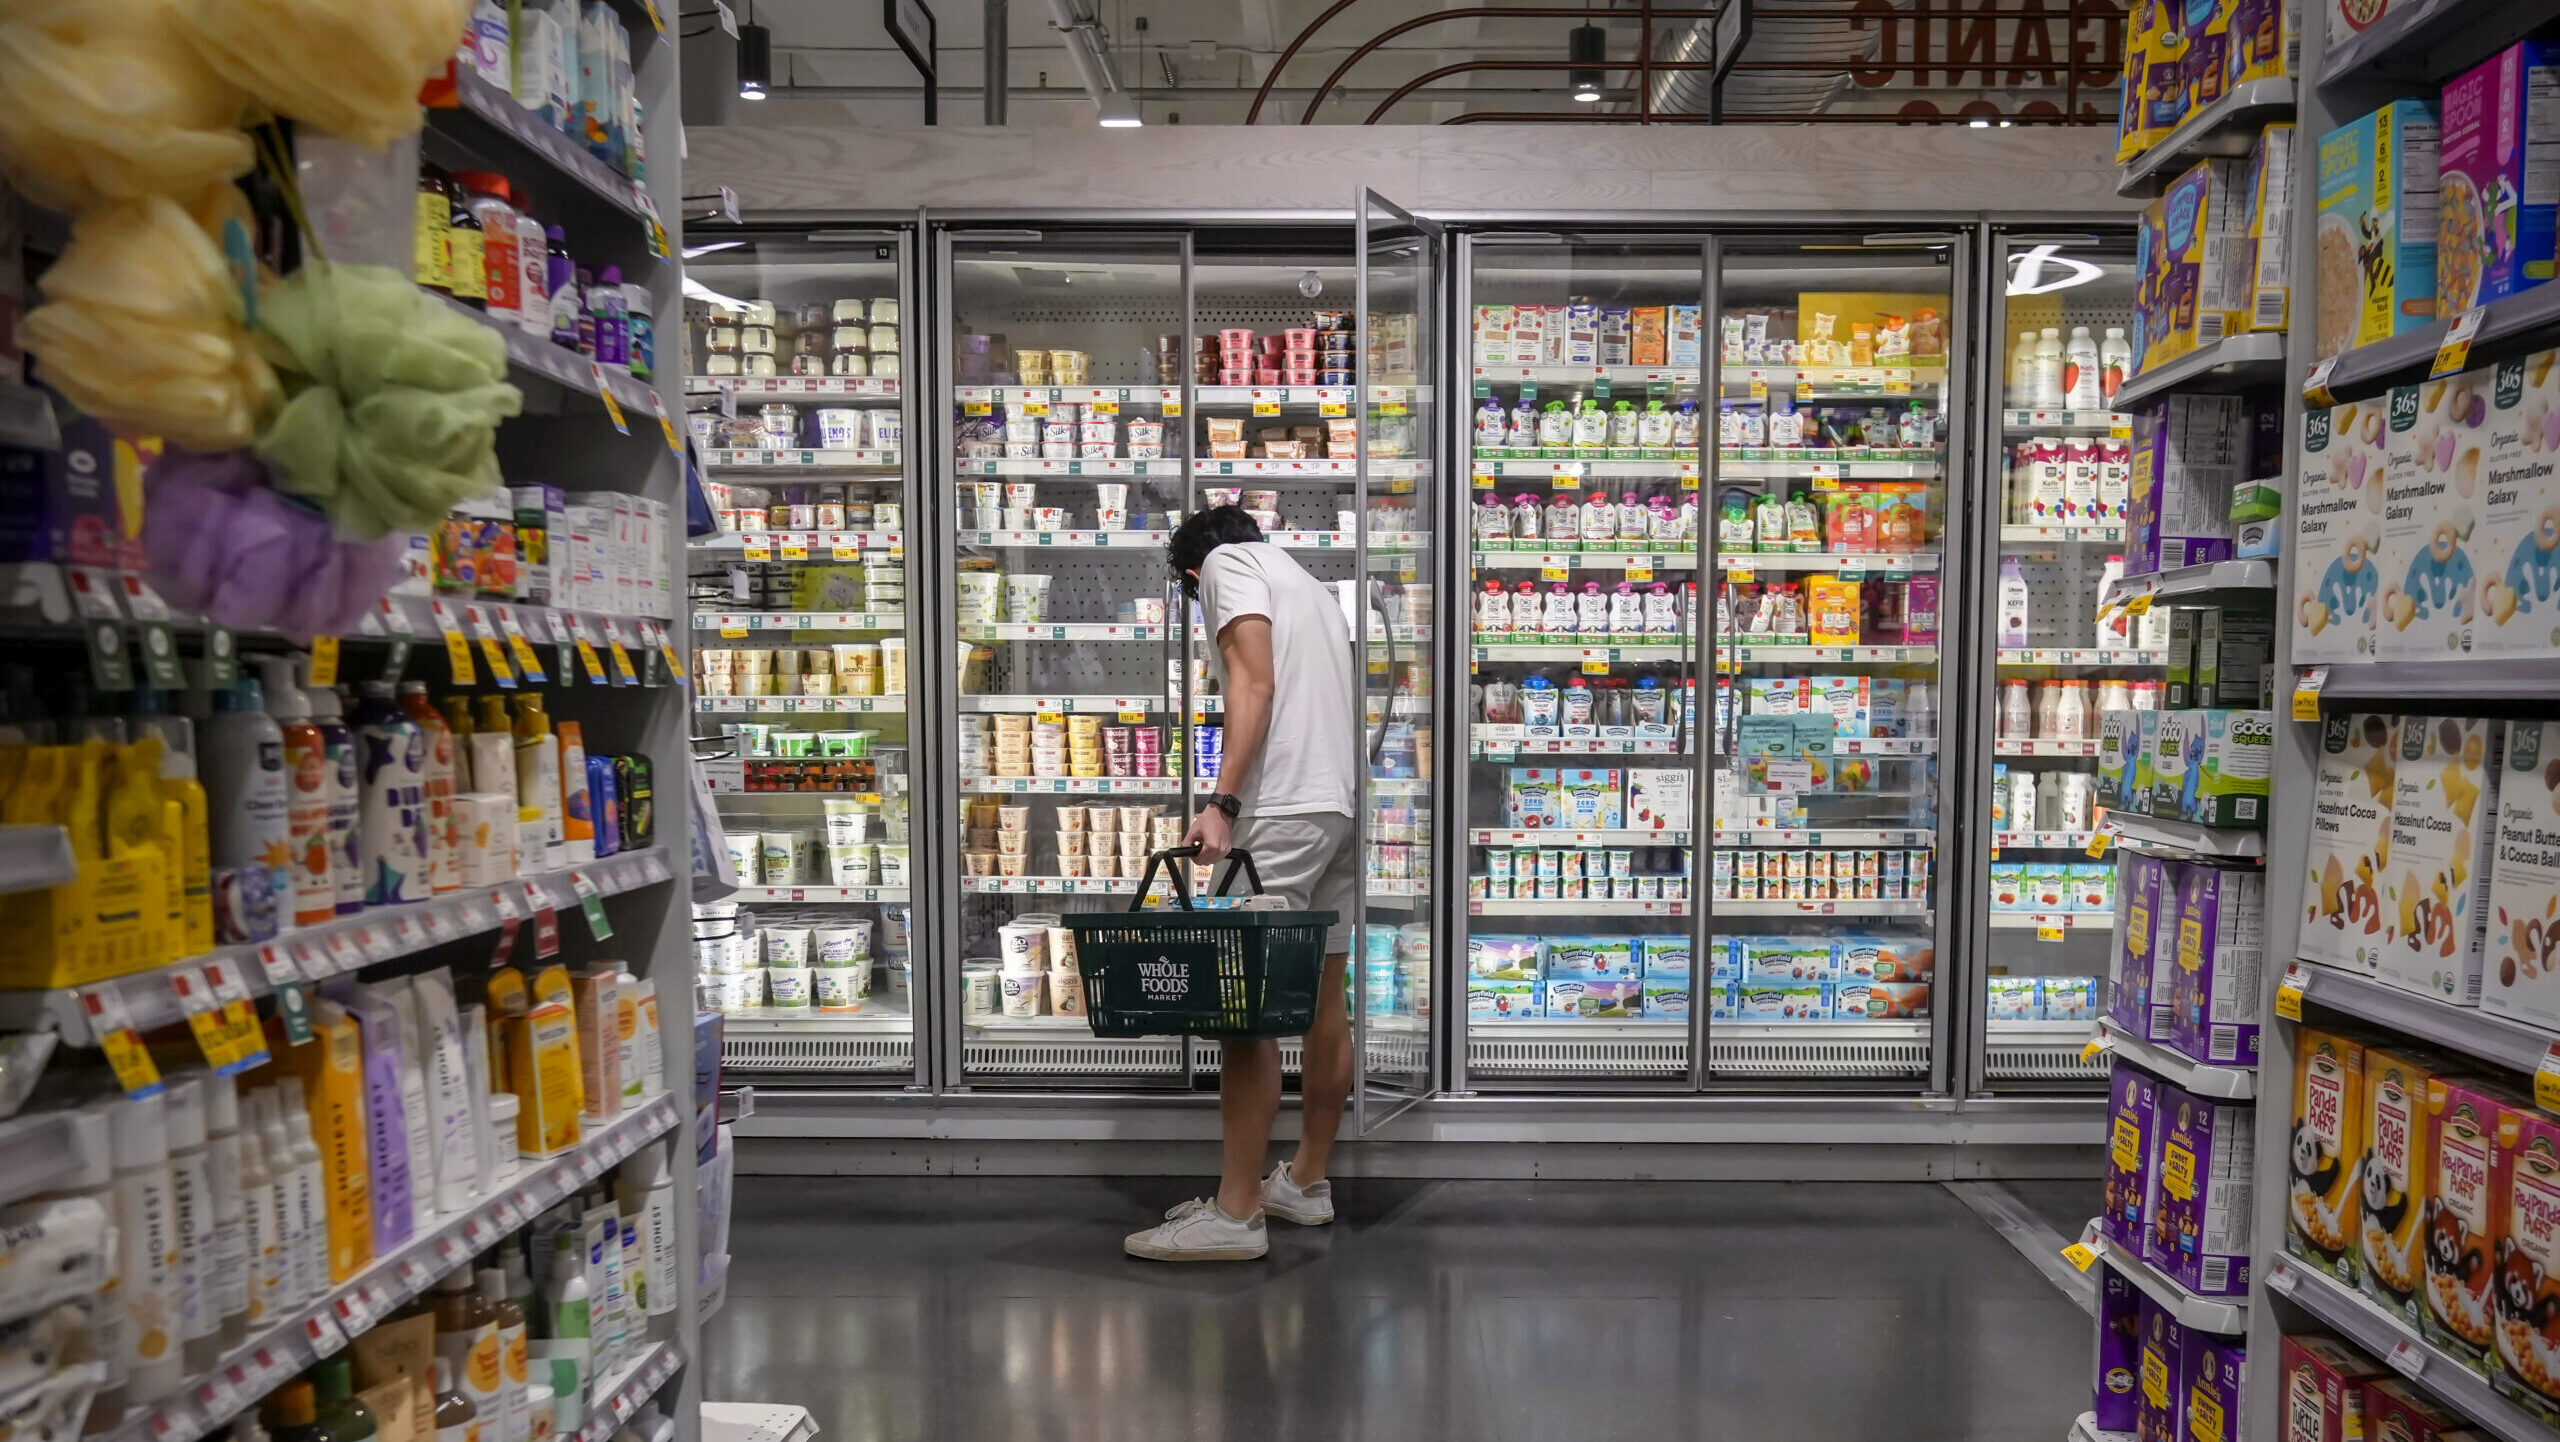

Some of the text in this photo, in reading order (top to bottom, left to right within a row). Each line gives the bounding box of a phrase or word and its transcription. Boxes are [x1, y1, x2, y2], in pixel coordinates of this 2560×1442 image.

[2378, 115, 2388, 128] 13
[2379, 142, 2385, 155] 6
[2379, 170, 2385, 182] 2
[879, 248, 887, 256] 13
[2497, 365, 2522, 392] 365
[2392, 392, 2418, 417] 365
[1050, 425, 1066, 437] Silk
[1134, 426, 1150, 438] Silk
[2307, 416, 2328, 438] 365
[2491, 431, 2519, 450] Organic
[2388, 451, 2412, 469] Organic
[2303, 470, 2327, 487] Organic
[2489, 462, 2554, 485] Marshmallow
[2386, 481, 2445, 501] Marshmallow
[2487, 489, 2518, 506] Galaxy
[2302, 498, 2356, 516] Marshmallow
[2386, 505, 2412, 520] Galaxy
[2301, 520, 2327, 534] Galaxy
[2103, 719, 2121, 738] GOGO
[2161, 722, 2182, 742] GOGO
[2327, 719, 2347, 739] 365
[2405, 722, 2424, 744] 365
[2512, 728, 2539, 752] 365
[2320, 769, 2343, 786] Organic
[2398, 778, 2419, 796] Organic
[2317, 801, 2376, 819] Hazelnut Cocoa
[2503, 803, 2534, 823] Organic
[2315, 817, 2339, 832] Pillows
[2394, 812, 2452, 832] Hazelnut Cocoa
[2392, 830, 2416, 846] Pillows
[2501, 825, 2533, 843] Peanut
[2500, 846, 2507, 860] &
[2508, 847, 2538, 865] Cocoa
[2151, 868, 2158, 881] 12
[2205, 878, 2214, 892] 12
[1562, 949, 1593, 959] Stonyfield
[1138, 961, 1190, 979] WHOLE
[1141, 978, 1189, 993] FOODS
[2143, 1088, 2151, 1102] 12
[2310, 1085, 2336, 1114] Panda
[372, 1084, 389, 1169] HONEST
[2199, 1111, 2208, 1125] 12
[2378, 1113, 2404, 1145] Panda
[2442, 1151, 2484, 1186] Red Panda
[2515, 1186, 2531, 1212] Red
[651, 1206, 662, 1253] HONEST
[2109, 1278, 2122, 1295] 12
[2170, 1325, 2177, 1341] 12
[2225, 1365, 2234, 1381] 12
